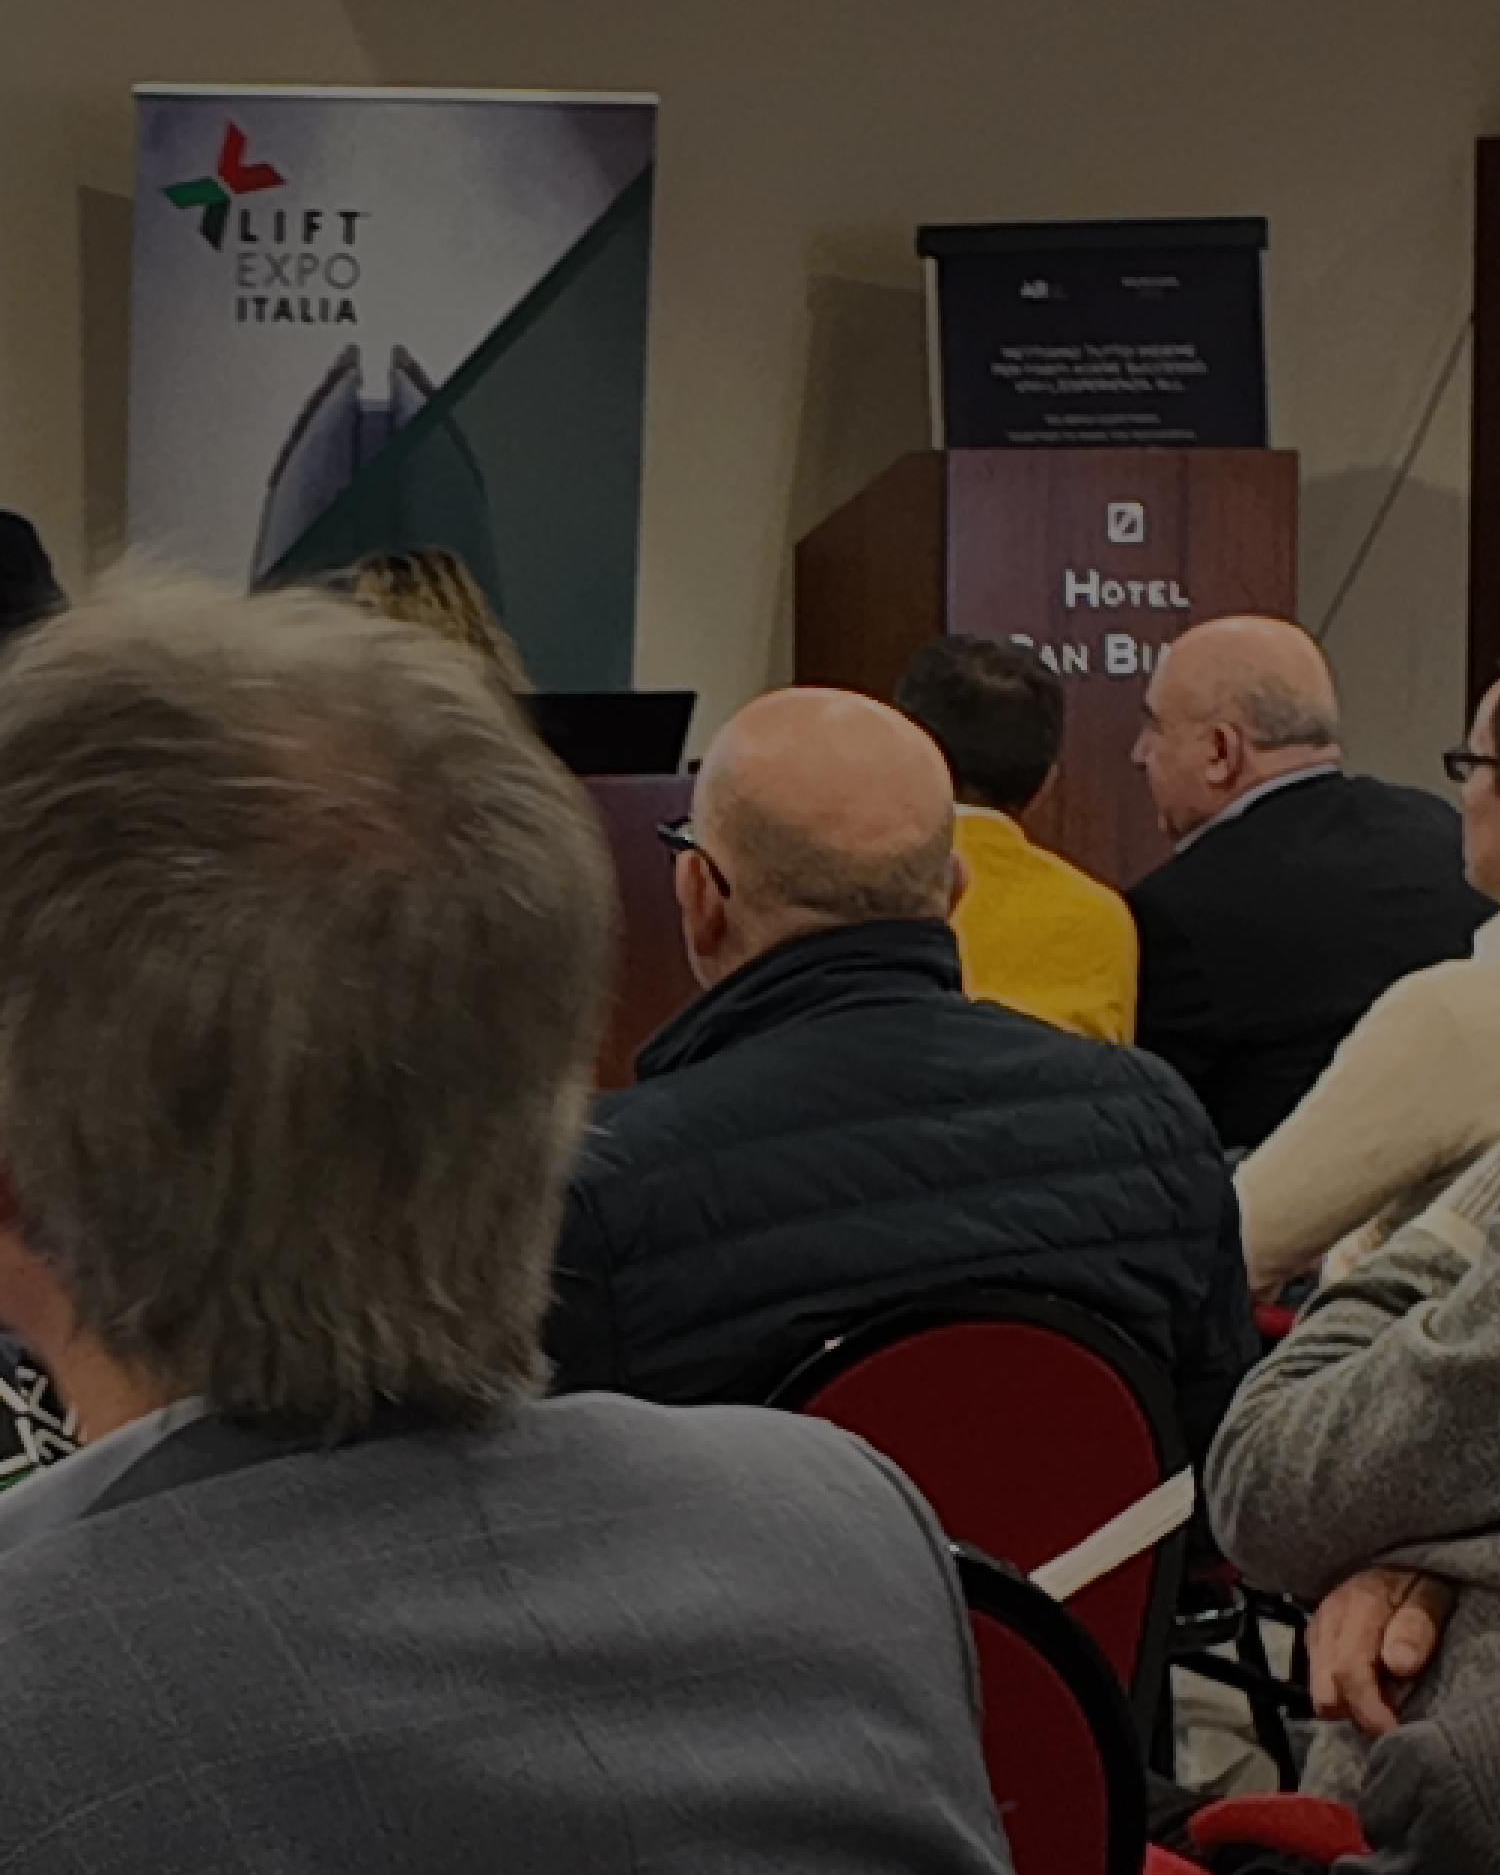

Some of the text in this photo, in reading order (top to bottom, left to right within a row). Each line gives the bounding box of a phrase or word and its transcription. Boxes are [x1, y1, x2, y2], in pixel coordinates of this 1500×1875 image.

[238, 209, 370, 247] LIFT
[236, 252, 361, 290] EXPO
[236, 295, 360, 324] ITALIA
[1064, 568, 1192, 609] HOTEL
[1009, 633, 1090, 676] AN
